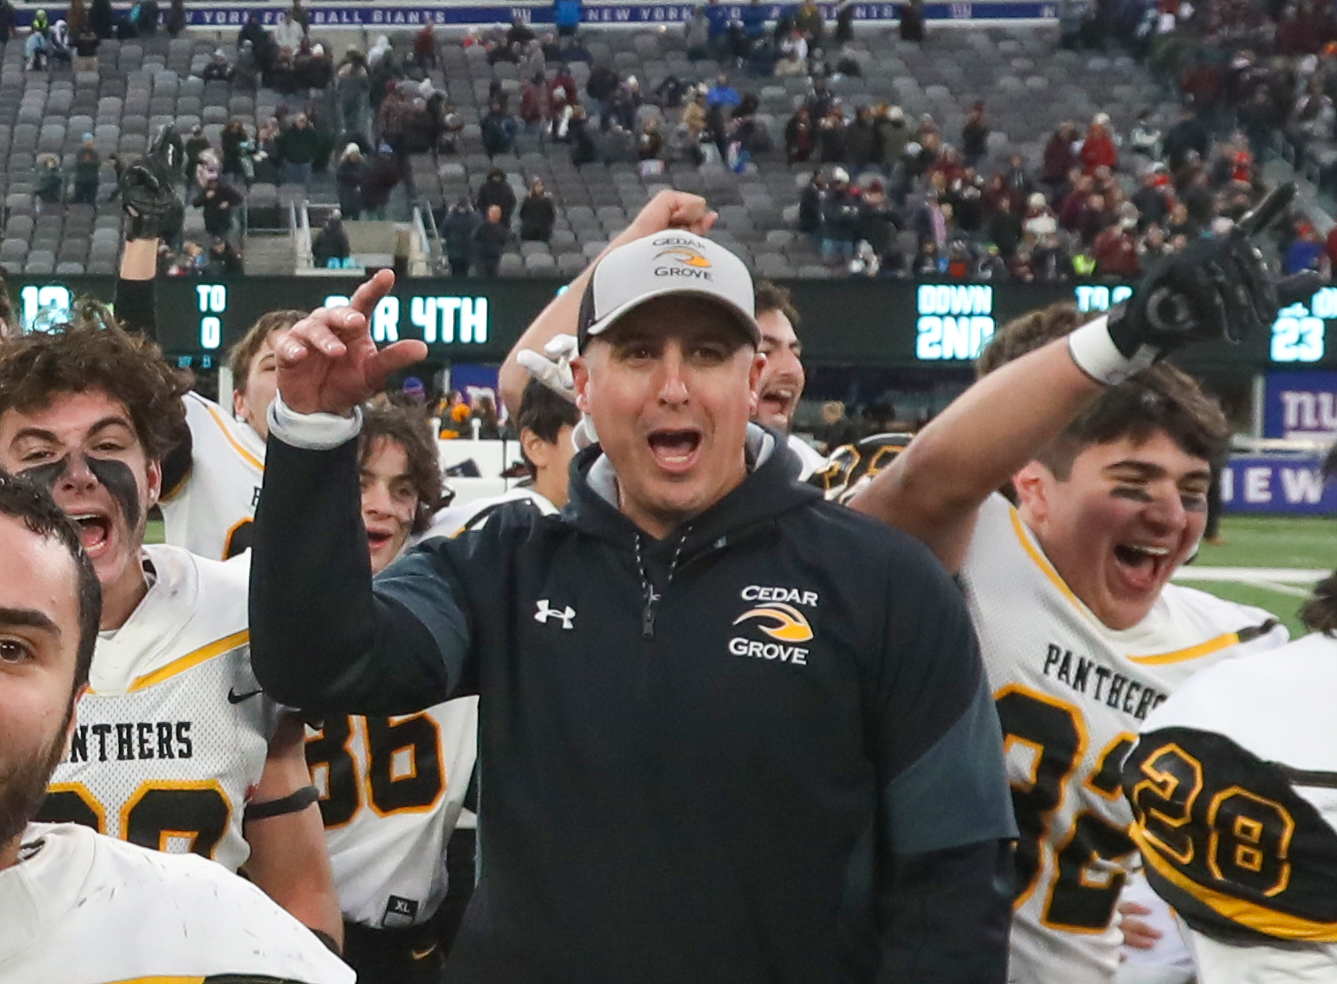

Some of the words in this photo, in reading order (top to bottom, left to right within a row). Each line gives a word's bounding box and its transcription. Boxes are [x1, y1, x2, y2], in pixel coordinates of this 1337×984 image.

[264, 11, 361, 24] FOBALL
[372, 11, 445, 24] GIANTS
[587, 8, 631, 21] NEW
[651, 238, 707, 250] CEDAR
[654, 266, 714, 281] GROVE
[196, 284, 226, 312] TO
[917, 285, 993, 315] DOWN
[411, 297, 488, 343] 4TH
[1270, 316, 1325, 362] 23
[741, 585, 818, 607] CEDAR
[728, 637, 809, 665] GROVE
[68, 721, 193, 763] NTHERS
[1133, 742, 1297, 898] 28
[395, 900, 411, 913] XL
